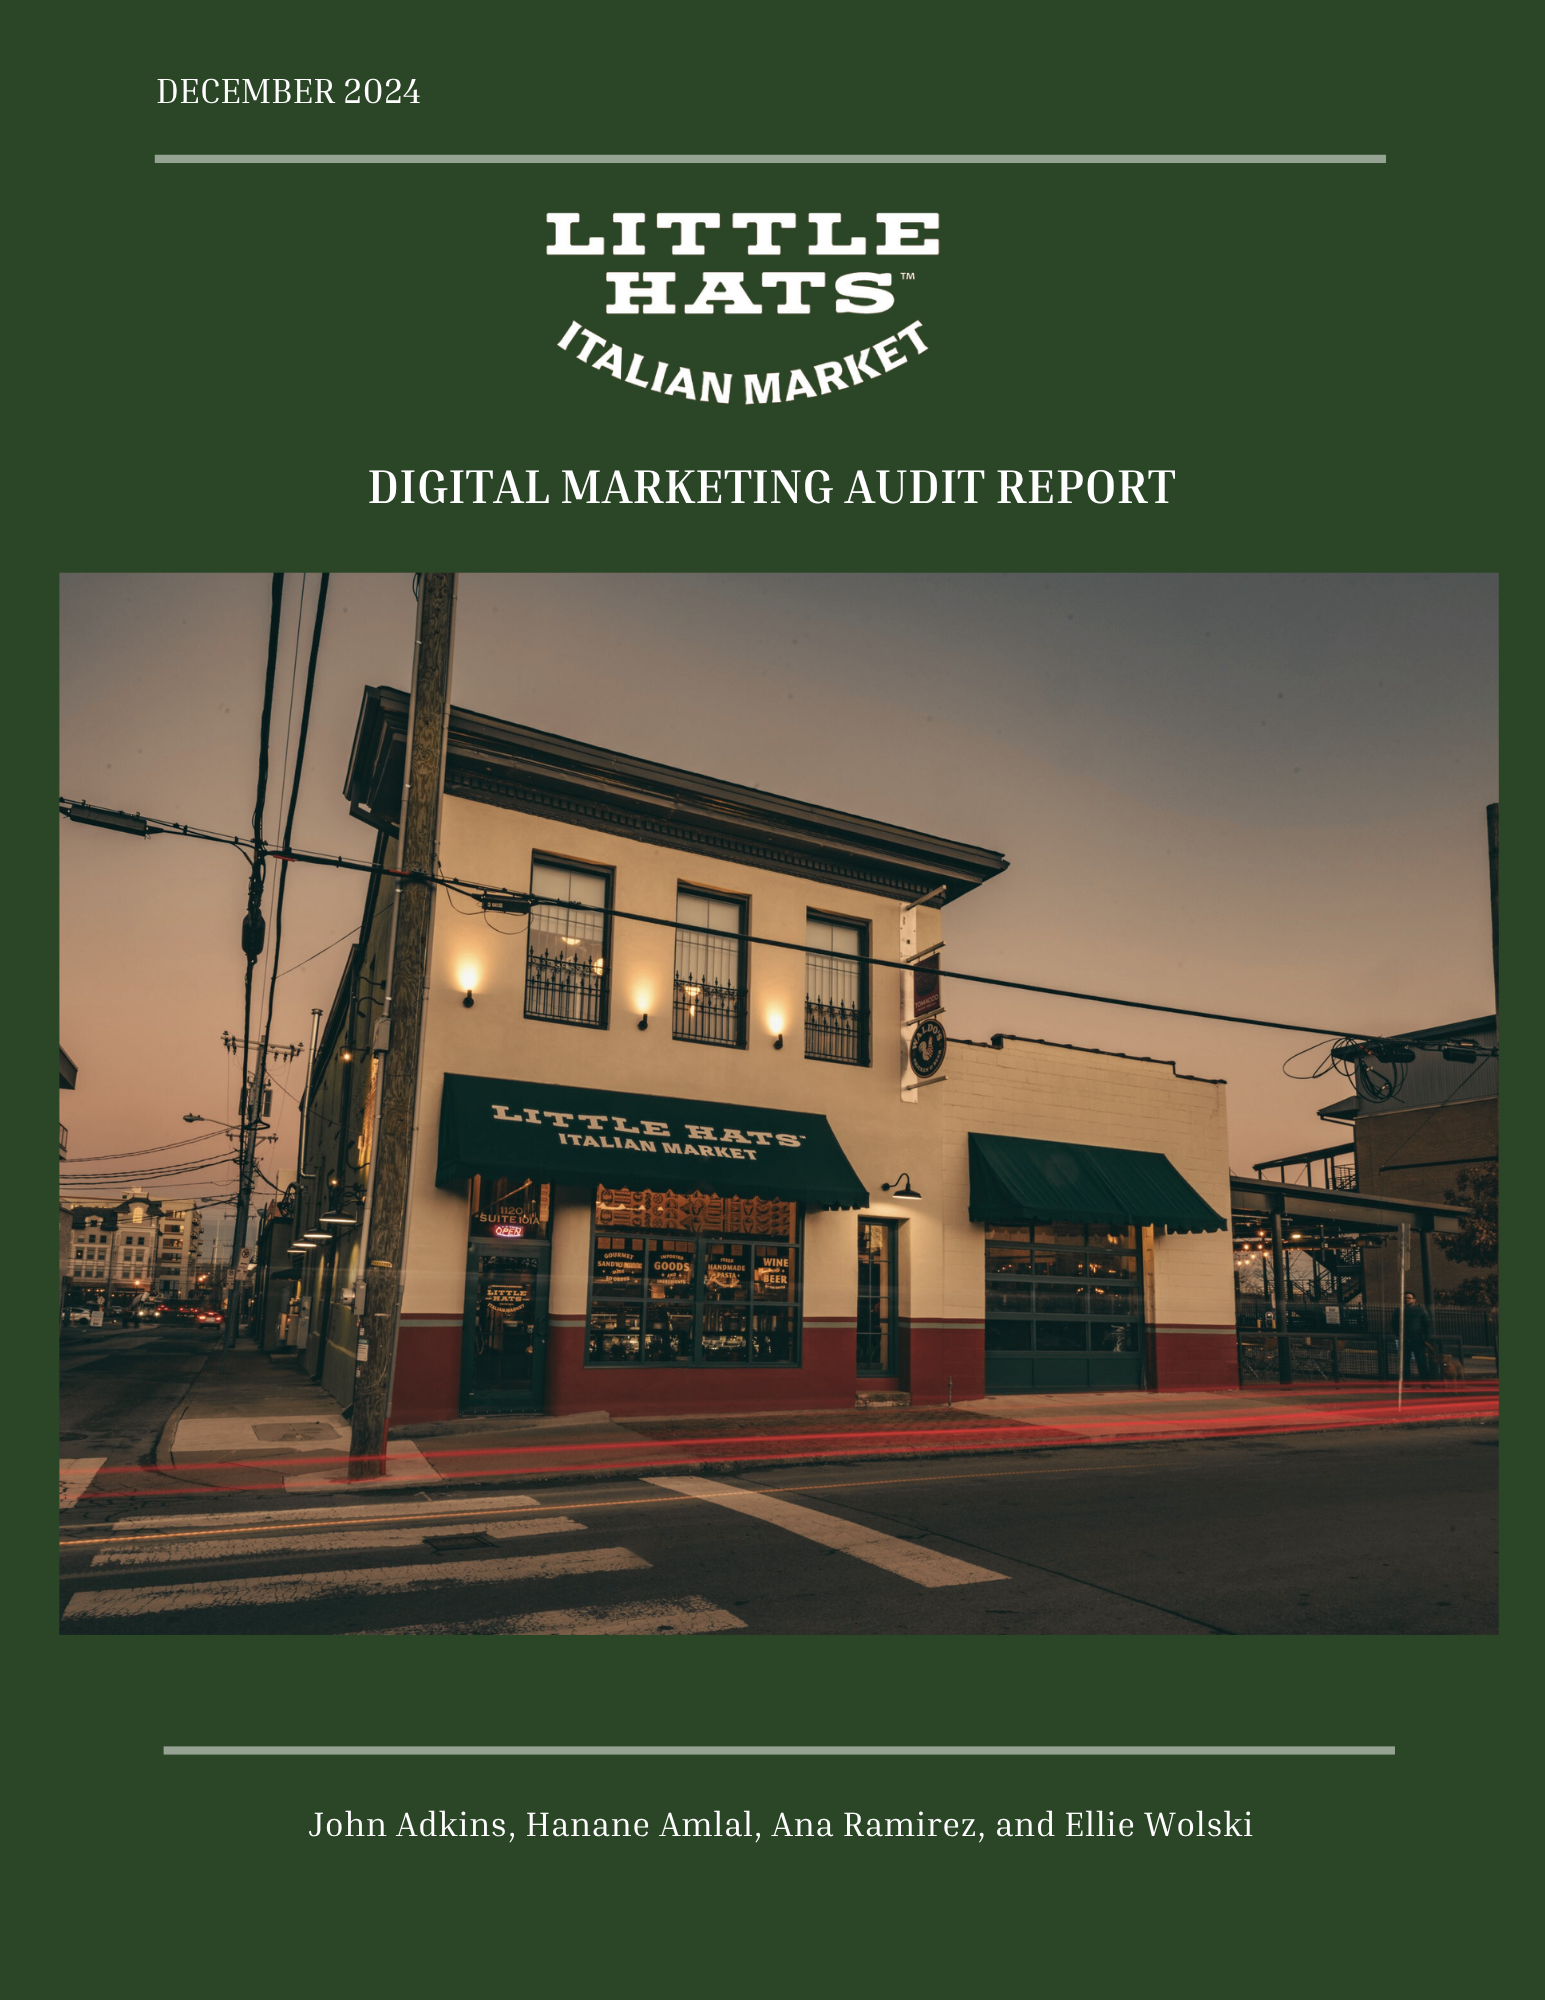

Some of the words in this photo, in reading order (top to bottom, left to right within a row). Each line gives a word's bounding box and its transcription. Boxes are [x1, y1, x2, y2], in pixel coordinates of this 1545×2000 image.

[912, 1024, 942, 1050] WALDO'S
[491, 1104, 671, 1137] LITTLE
[684, 1124, 802, 1148] HATS
[557, 1132, 657, 1154] ITALIAN
[661, 1142, 757, 1161] MARKET
[500, 1206, 523, 1215] 1120
[480, 1214, 516, 1224] SUITE
[495, 1227, 522, 1236] OPEN
[603, 1252, 635, 1260] GOURMET
[654, 1261, 690, 1272] GOODS
[763, 1258, 789, 1267] WINE
[763, 1274, 788, 1284] BEER
